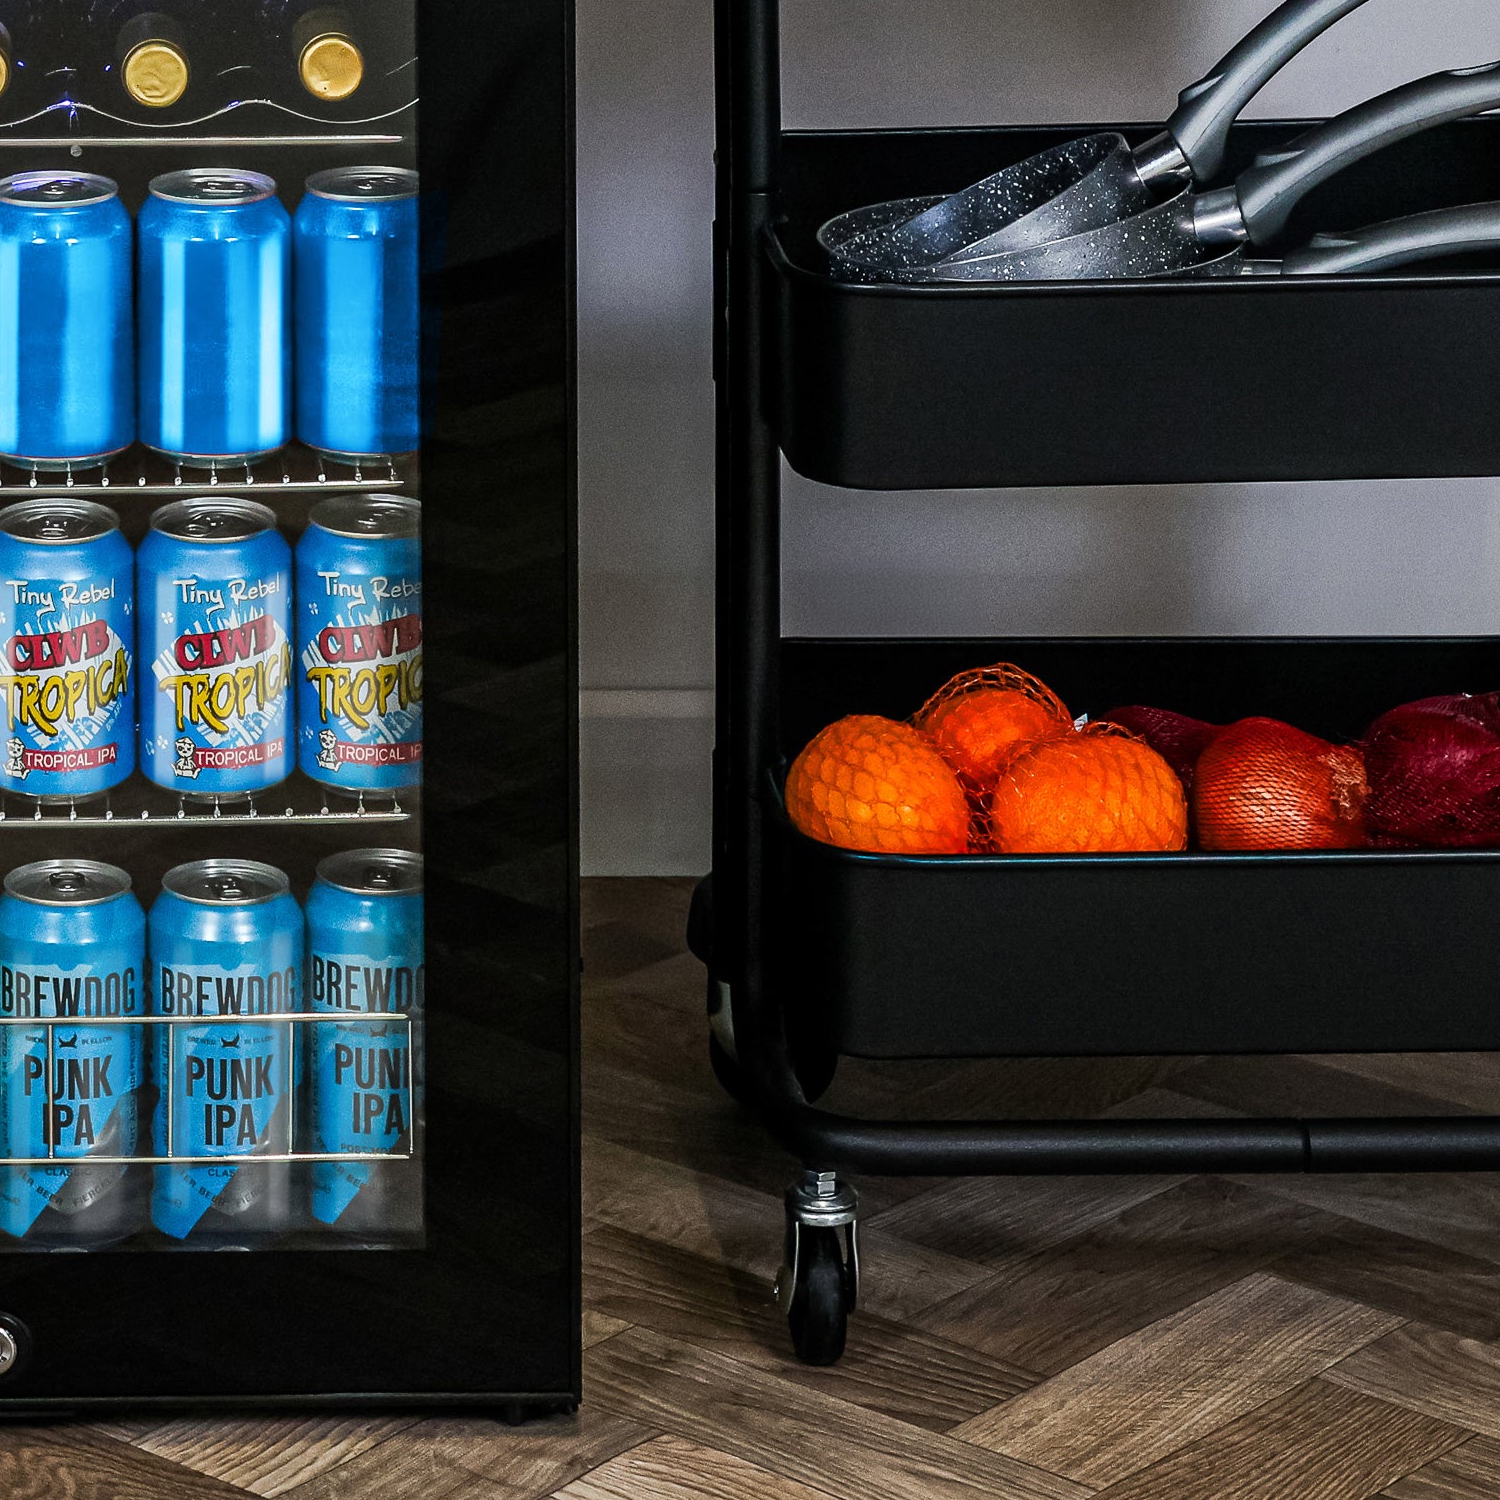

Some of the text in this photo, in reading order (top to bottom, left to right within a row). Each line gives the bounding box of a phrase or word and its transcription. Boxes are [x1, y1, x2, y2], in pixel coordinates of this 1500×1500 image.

[5, 578, 115, 618] Tiny Rebel
[173, 572, 281, 617] Tiny Rebel
[318, 572, 422, 612] Tiny Rebe
[4, 619, 109, 671] CLWB
[175, 614, 276, 670] CLWB
[319, 613, 422, 664] CLWB
[307, 653, 422, 730] TROPIC
[26, 747, 117, 767] TROPICAL IPA
[196, 744, 283, 767] TROPICAL IPA
[337, 744, 404, 762] TROPICAL
[1, 966, 135, 1017] BREWDOG
[161, 966, 296, 1016] BREWDOG
[312, 954, 424, 1013] BREWDO
[24, 1054, 113, 1100] PUNK
[186, 1054, 275, 1100] PUNK
[43, 1103, 95, 1146] IPA
[204, 1103, 257, 1147] IPA
[353, 1092, 405, 1135] IPA
